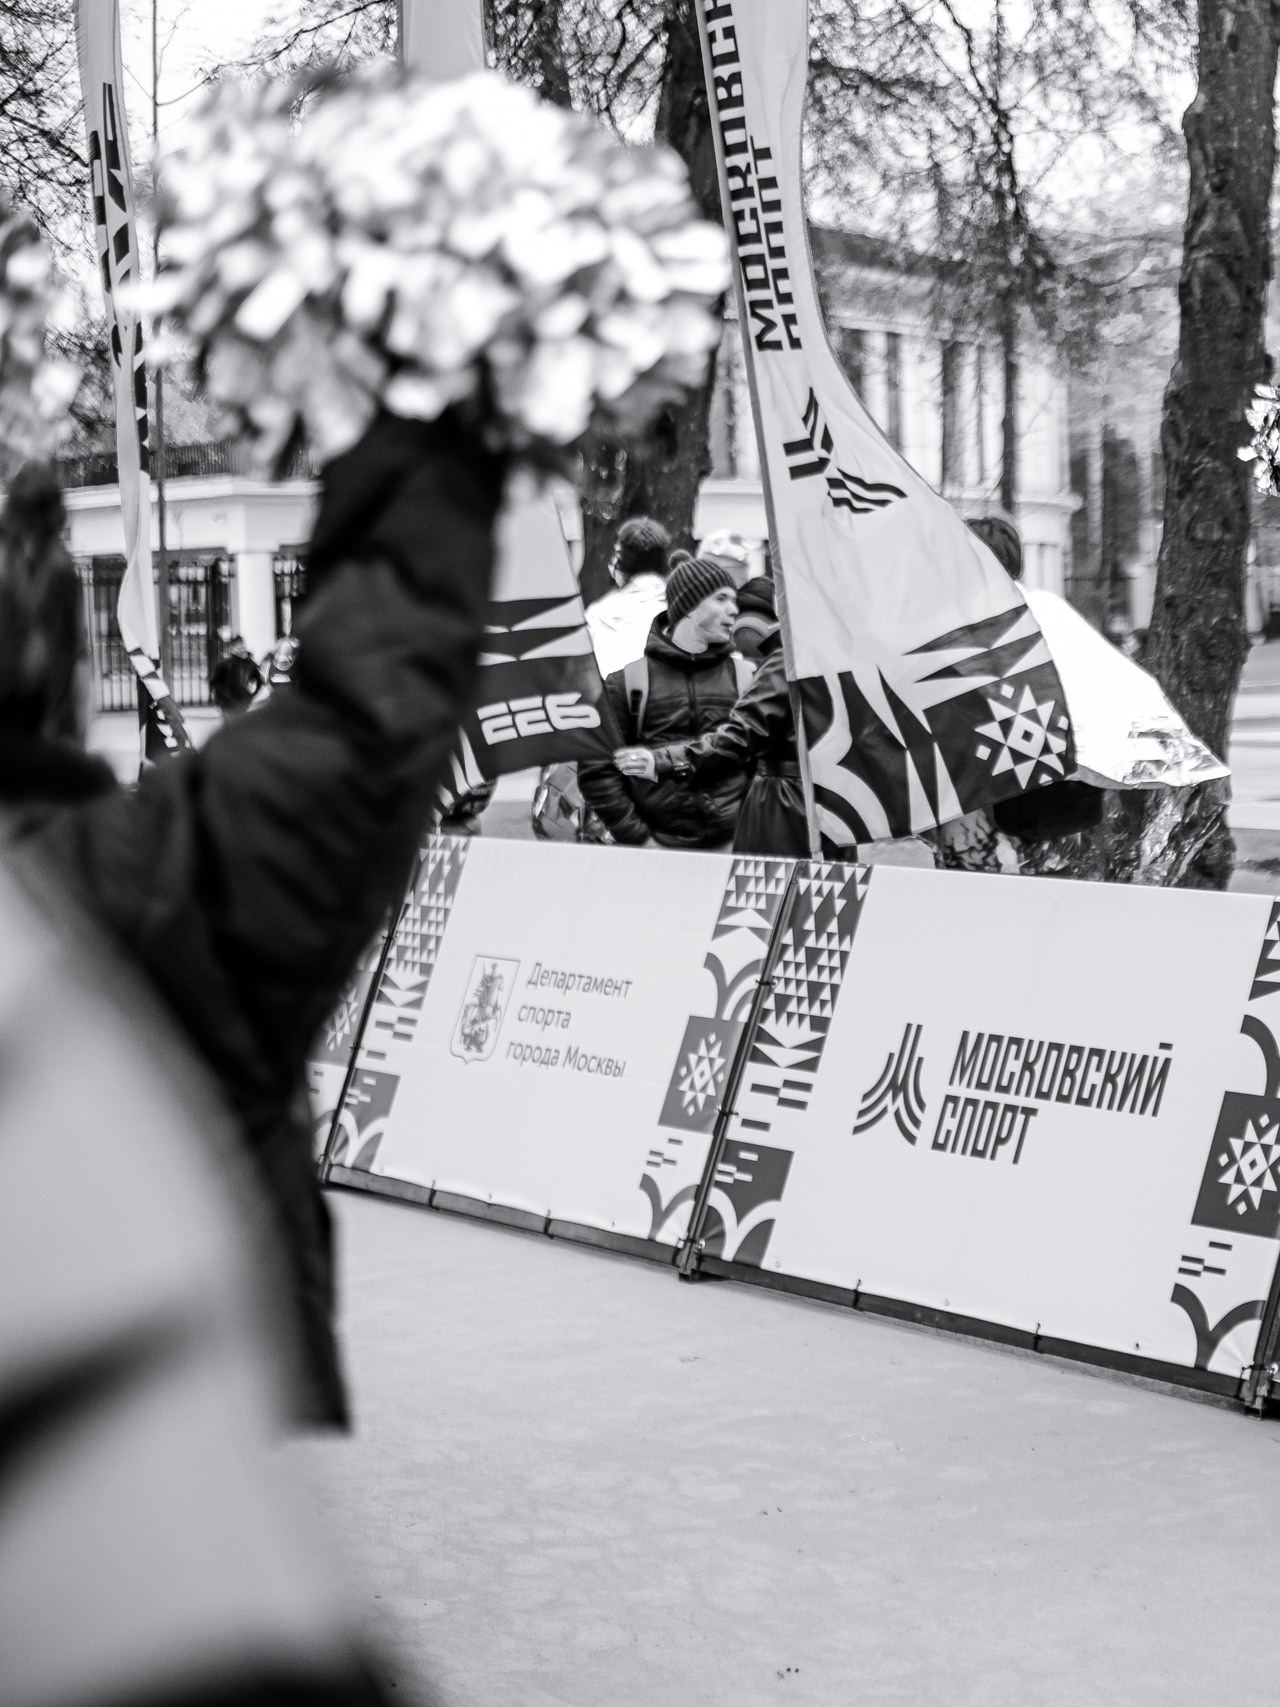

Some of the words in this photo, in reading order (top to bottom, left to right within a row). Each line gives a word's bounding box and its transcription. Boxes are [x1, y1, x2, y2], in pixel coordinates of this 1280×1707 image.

[526, 961, 633, 999] Департамент
[517, 1003, 572, 1031] спорта
[506, 1040, 560, 1068] города
[562, 1045, 627, 1079] Москвы
[949, 1030, 1174, 1118] МОСКОВСКИЙ
[931, 1094, 1039, 1165] СПОРТ
